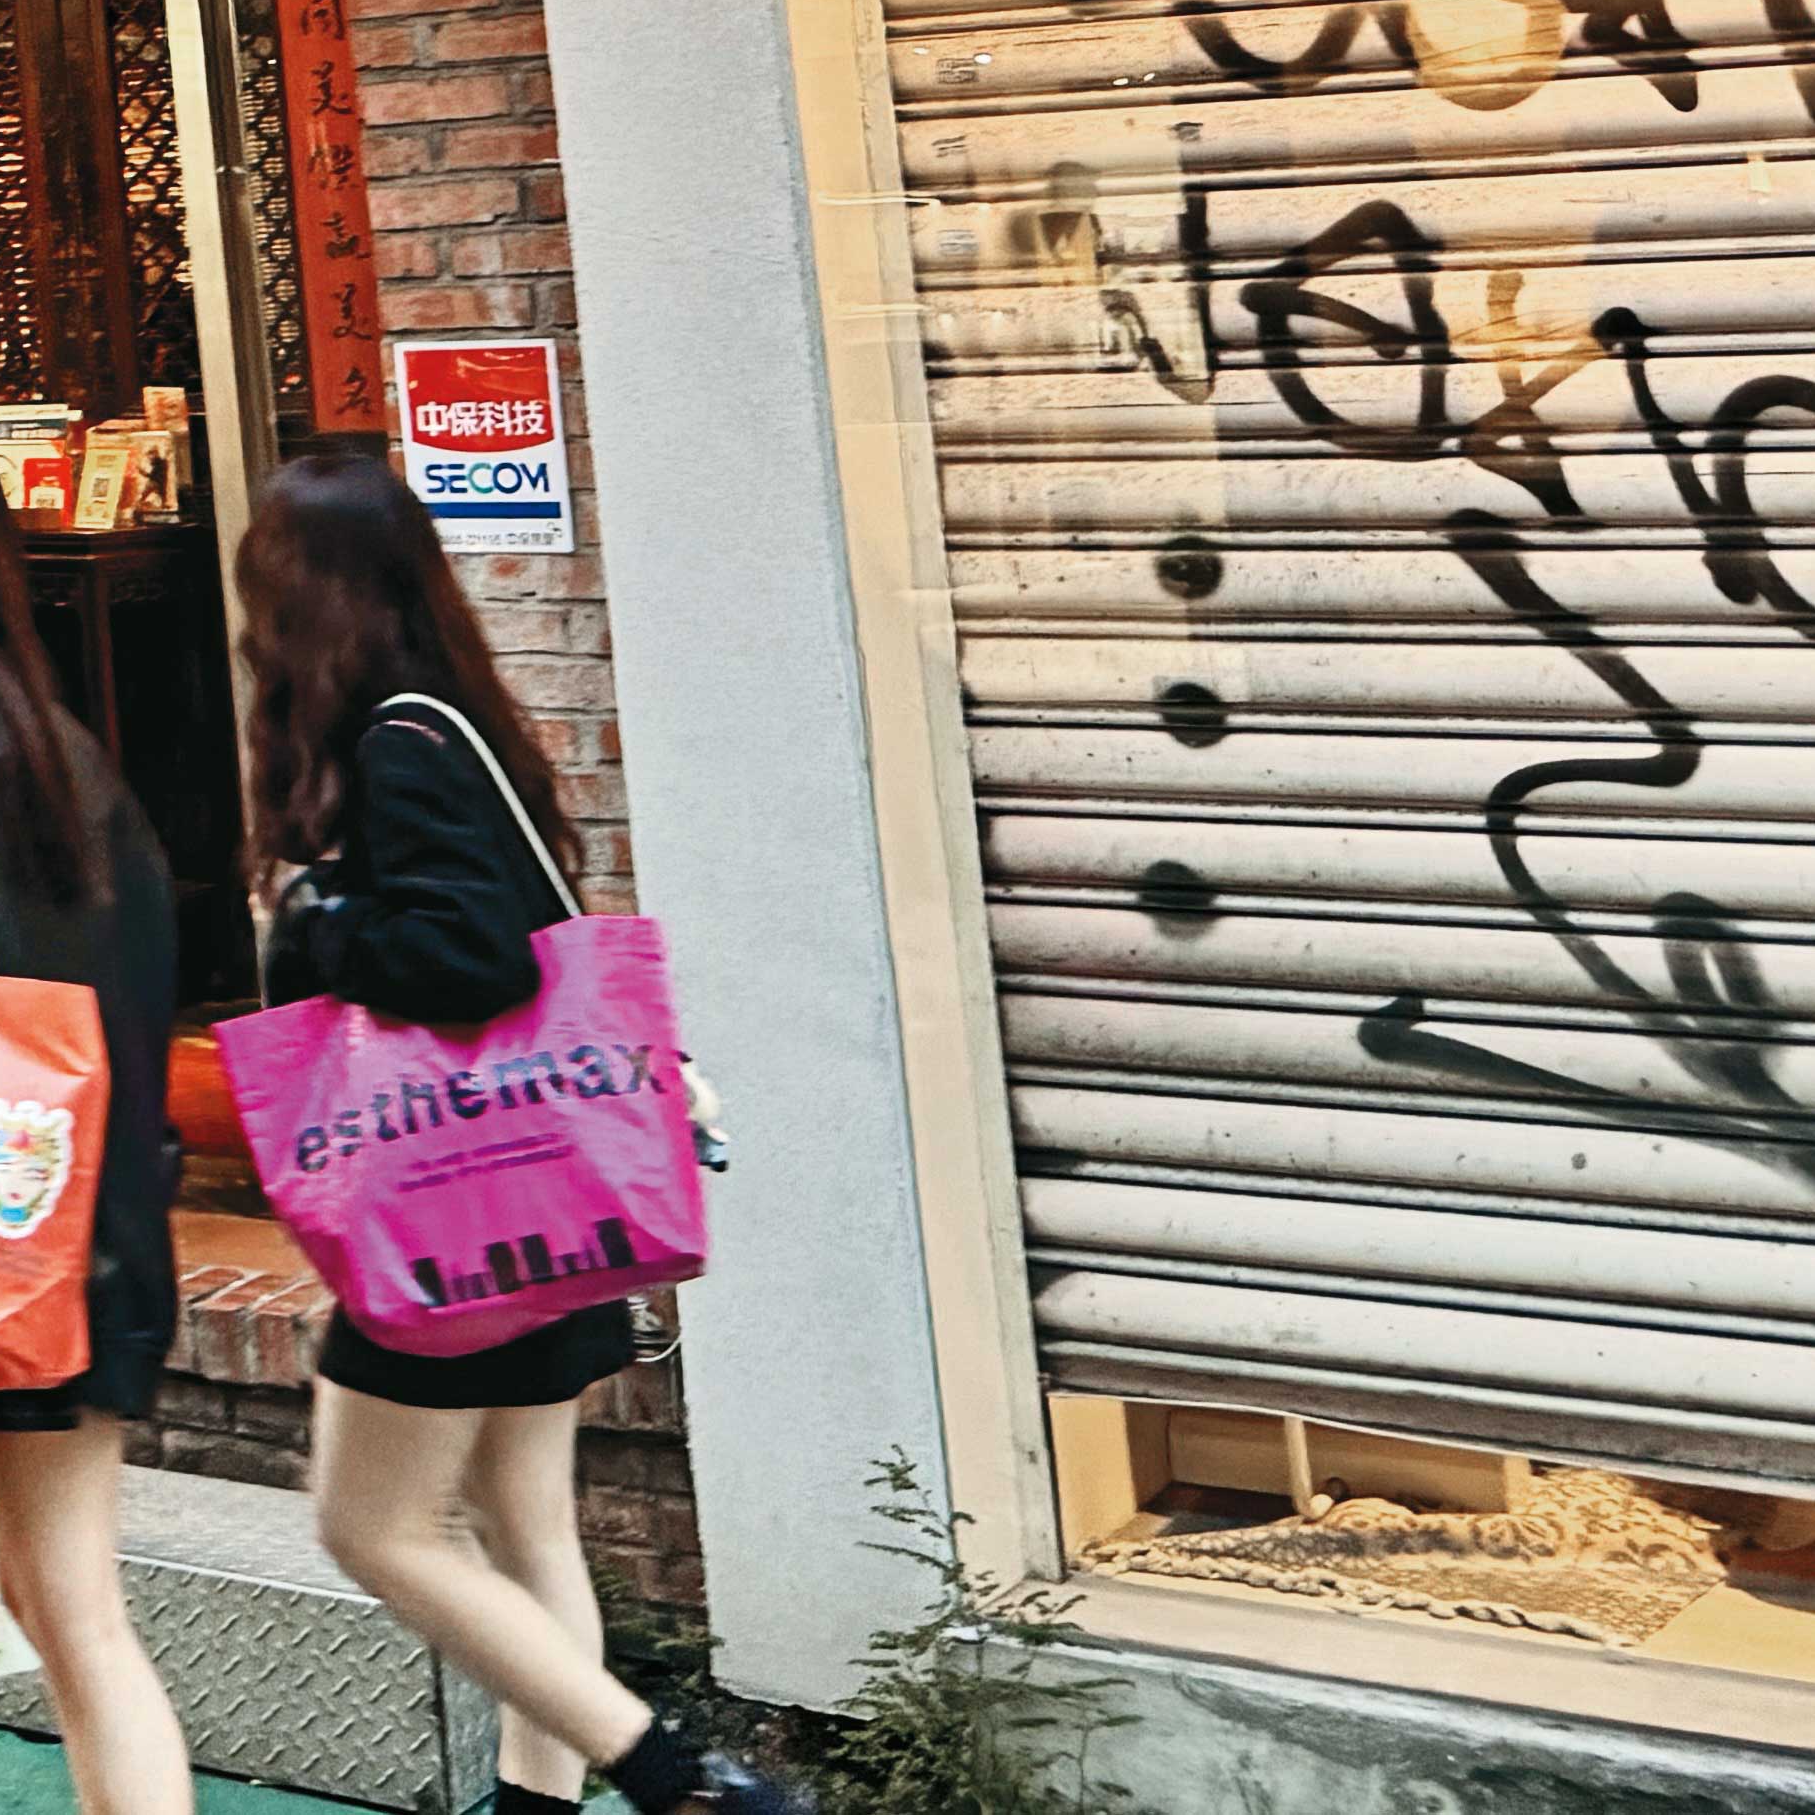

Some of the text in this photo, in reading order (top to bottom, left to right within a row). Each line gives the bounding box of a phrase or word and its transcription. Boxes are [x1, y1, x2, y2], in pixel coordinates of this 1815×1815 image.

[416, 400, 548, 437] 中保科技
[425, 462, 550, 494] SECOM
[296, 1043, 667, 1173] esthemax
